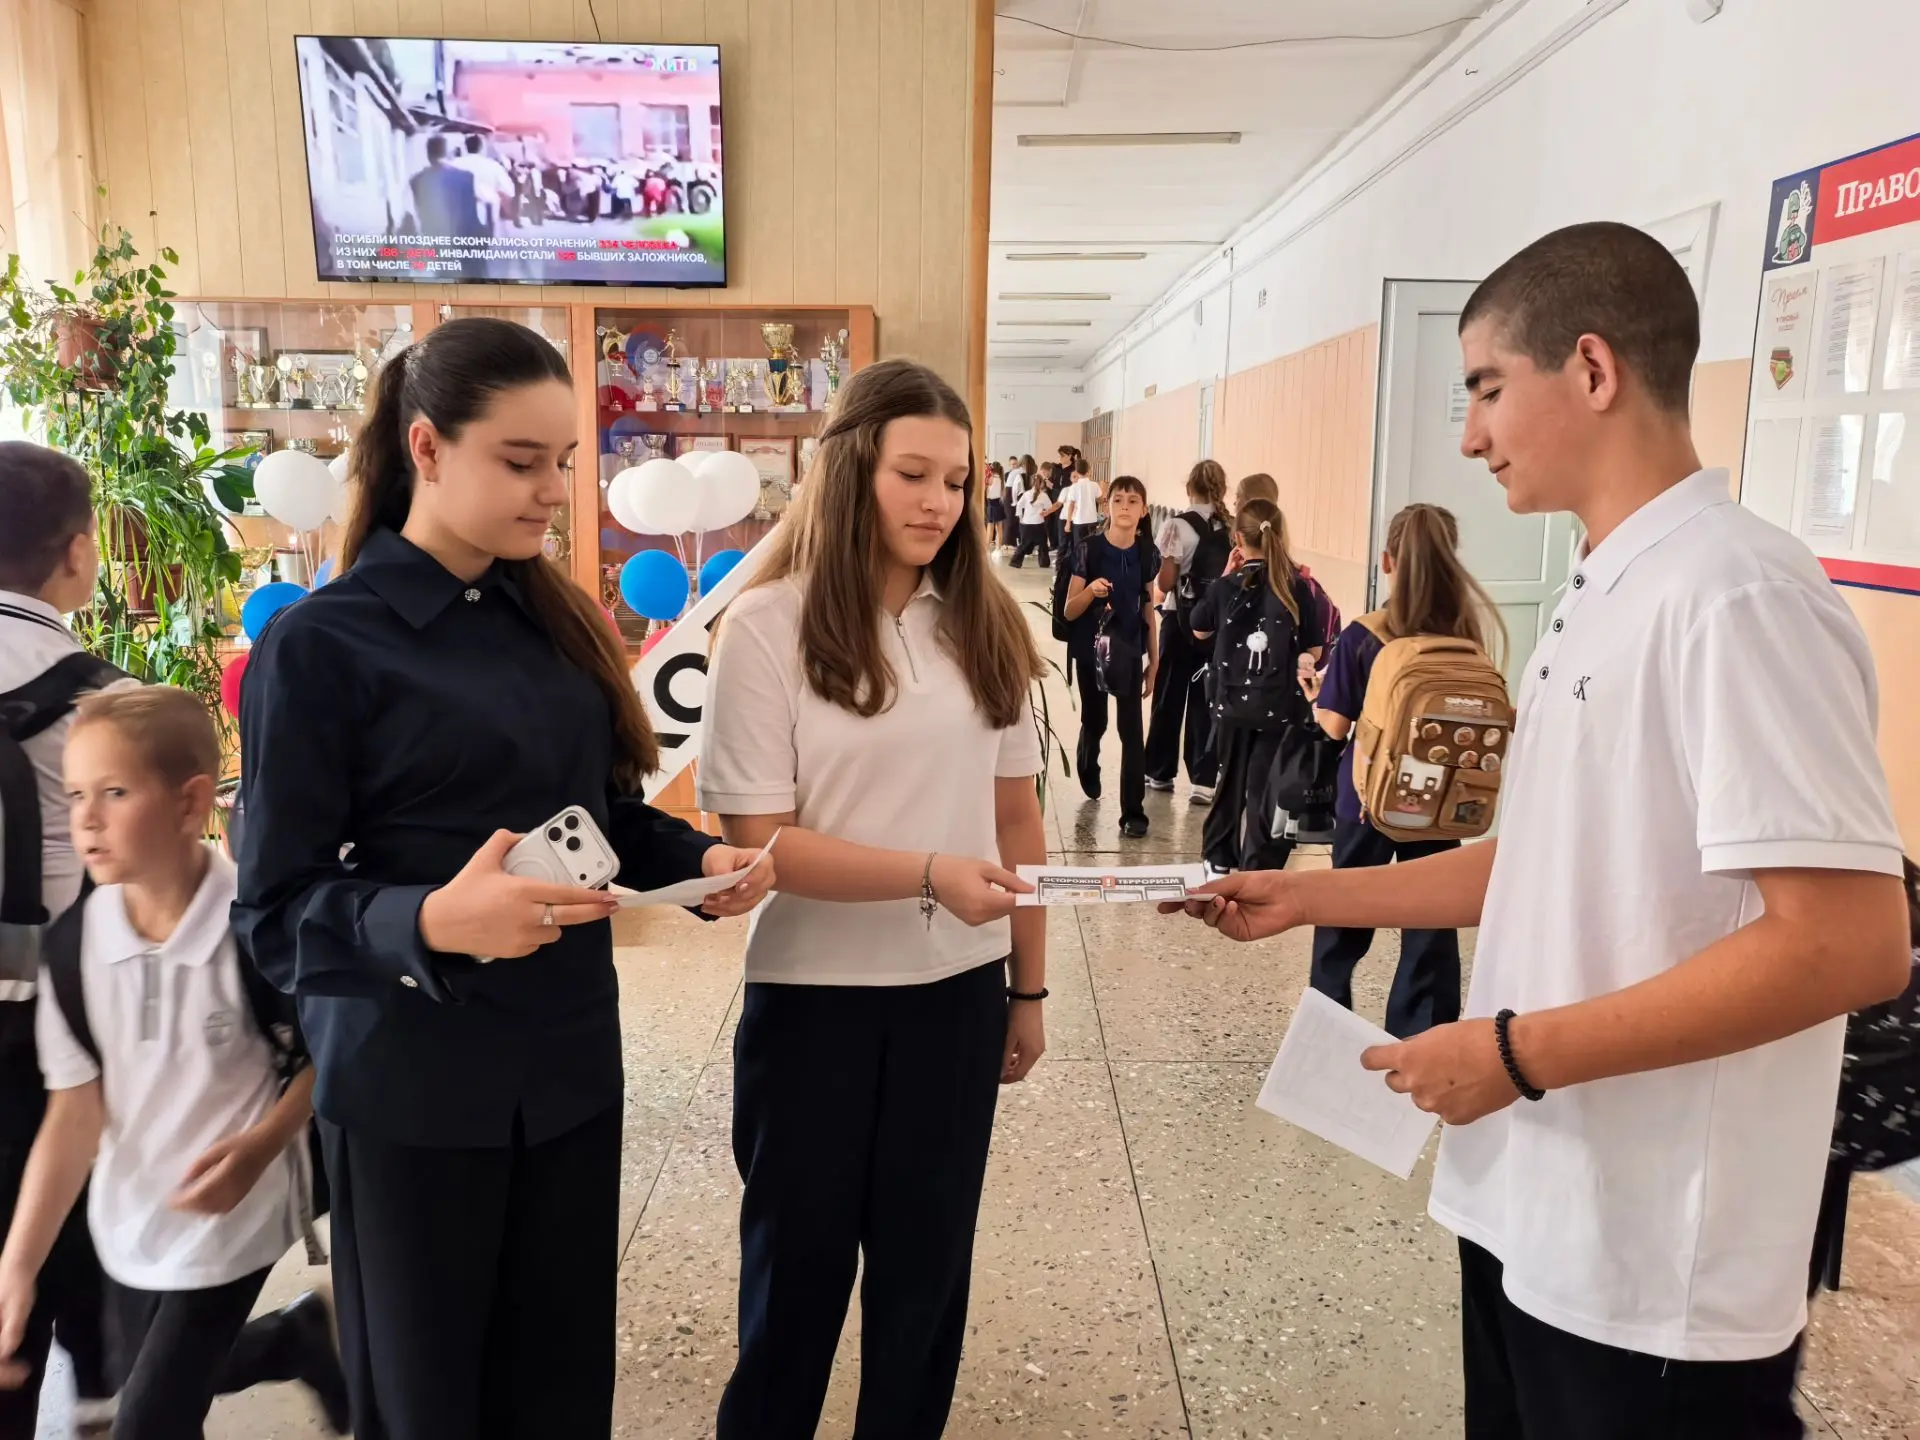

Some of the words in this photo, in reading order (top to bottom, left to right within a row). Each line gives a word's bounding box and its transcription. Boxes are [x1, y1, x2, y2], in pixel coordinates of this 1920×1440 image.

[335, 234, 388, 244] ПОГИБЛИ
[389, 235, 398, 244] И
[400, 235, 451, 246] ПОЗДНЕЕ
[453, 237, 528, 247] СКОНЧАЛИСЬ
[531, 238, 544, 247] ОТ
[546, 238, 597, 248] РАНЕНИЙ
[336, 247, 351, 256] ИЗ
[353, 248, 376, 257] НИХ
[440, 249, 518, 259] ИНВАЛИДАМИ
[522, 250, 555, 260] СТАЛИ
[577, 252, 625, 262] БЫВШИХ
[627, 252, 707, 264] ЗАЛОЖНИКОВ,
[337, 260, 344, 269] В
[347, 260, 370, 269] ТОМ
[372, 260, 410, 269] ЧИСЛЕ
[426, 260, 462, 271] ДЕТЕЙ
[1043, 877, 1101, 885] ОСТОРОЖНО
